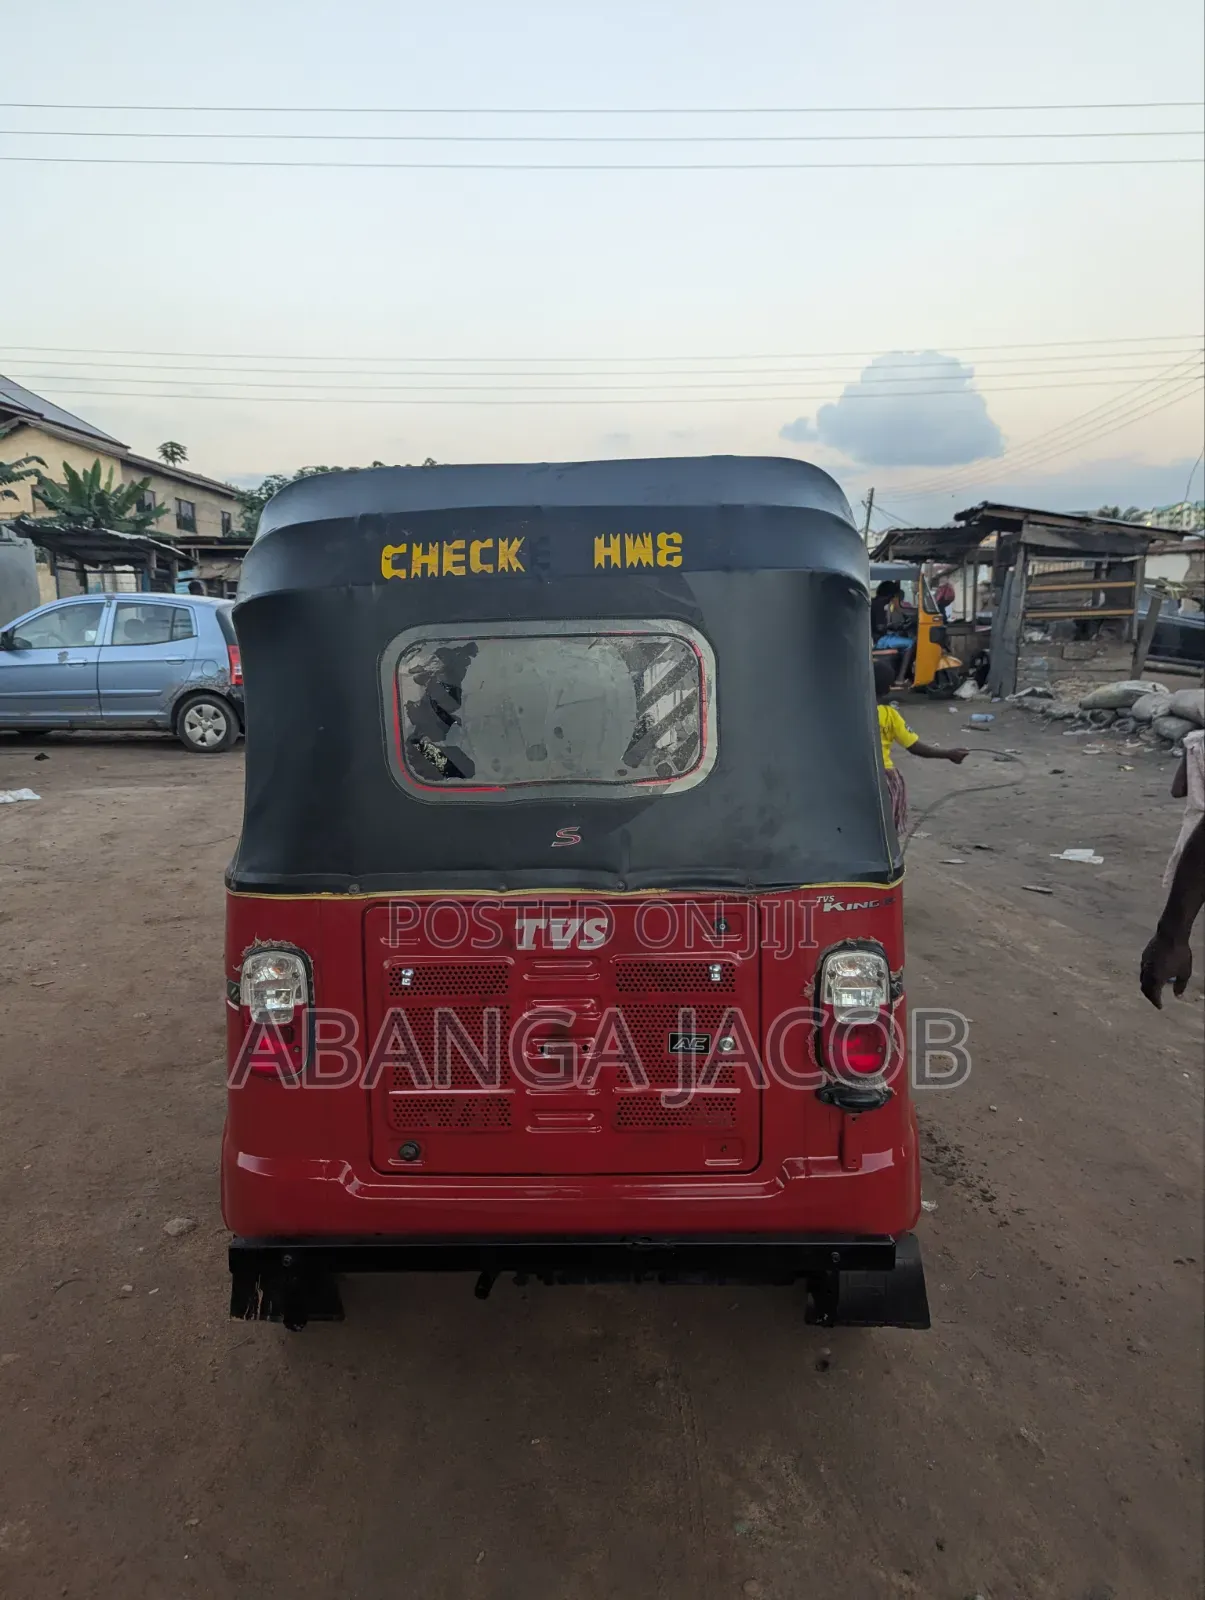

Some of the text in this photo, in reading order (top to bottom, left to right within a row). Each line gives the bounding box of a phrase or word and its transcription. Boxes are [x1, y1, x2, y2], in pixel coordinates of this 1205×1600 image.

[381, 536, 526, 579] CHECK
[551, 826, 581, 847] S
[816, 895, 835, 904] TVS
[514, 917, 609, 951] TVS
[672, 1037, 708, 1051] AC
